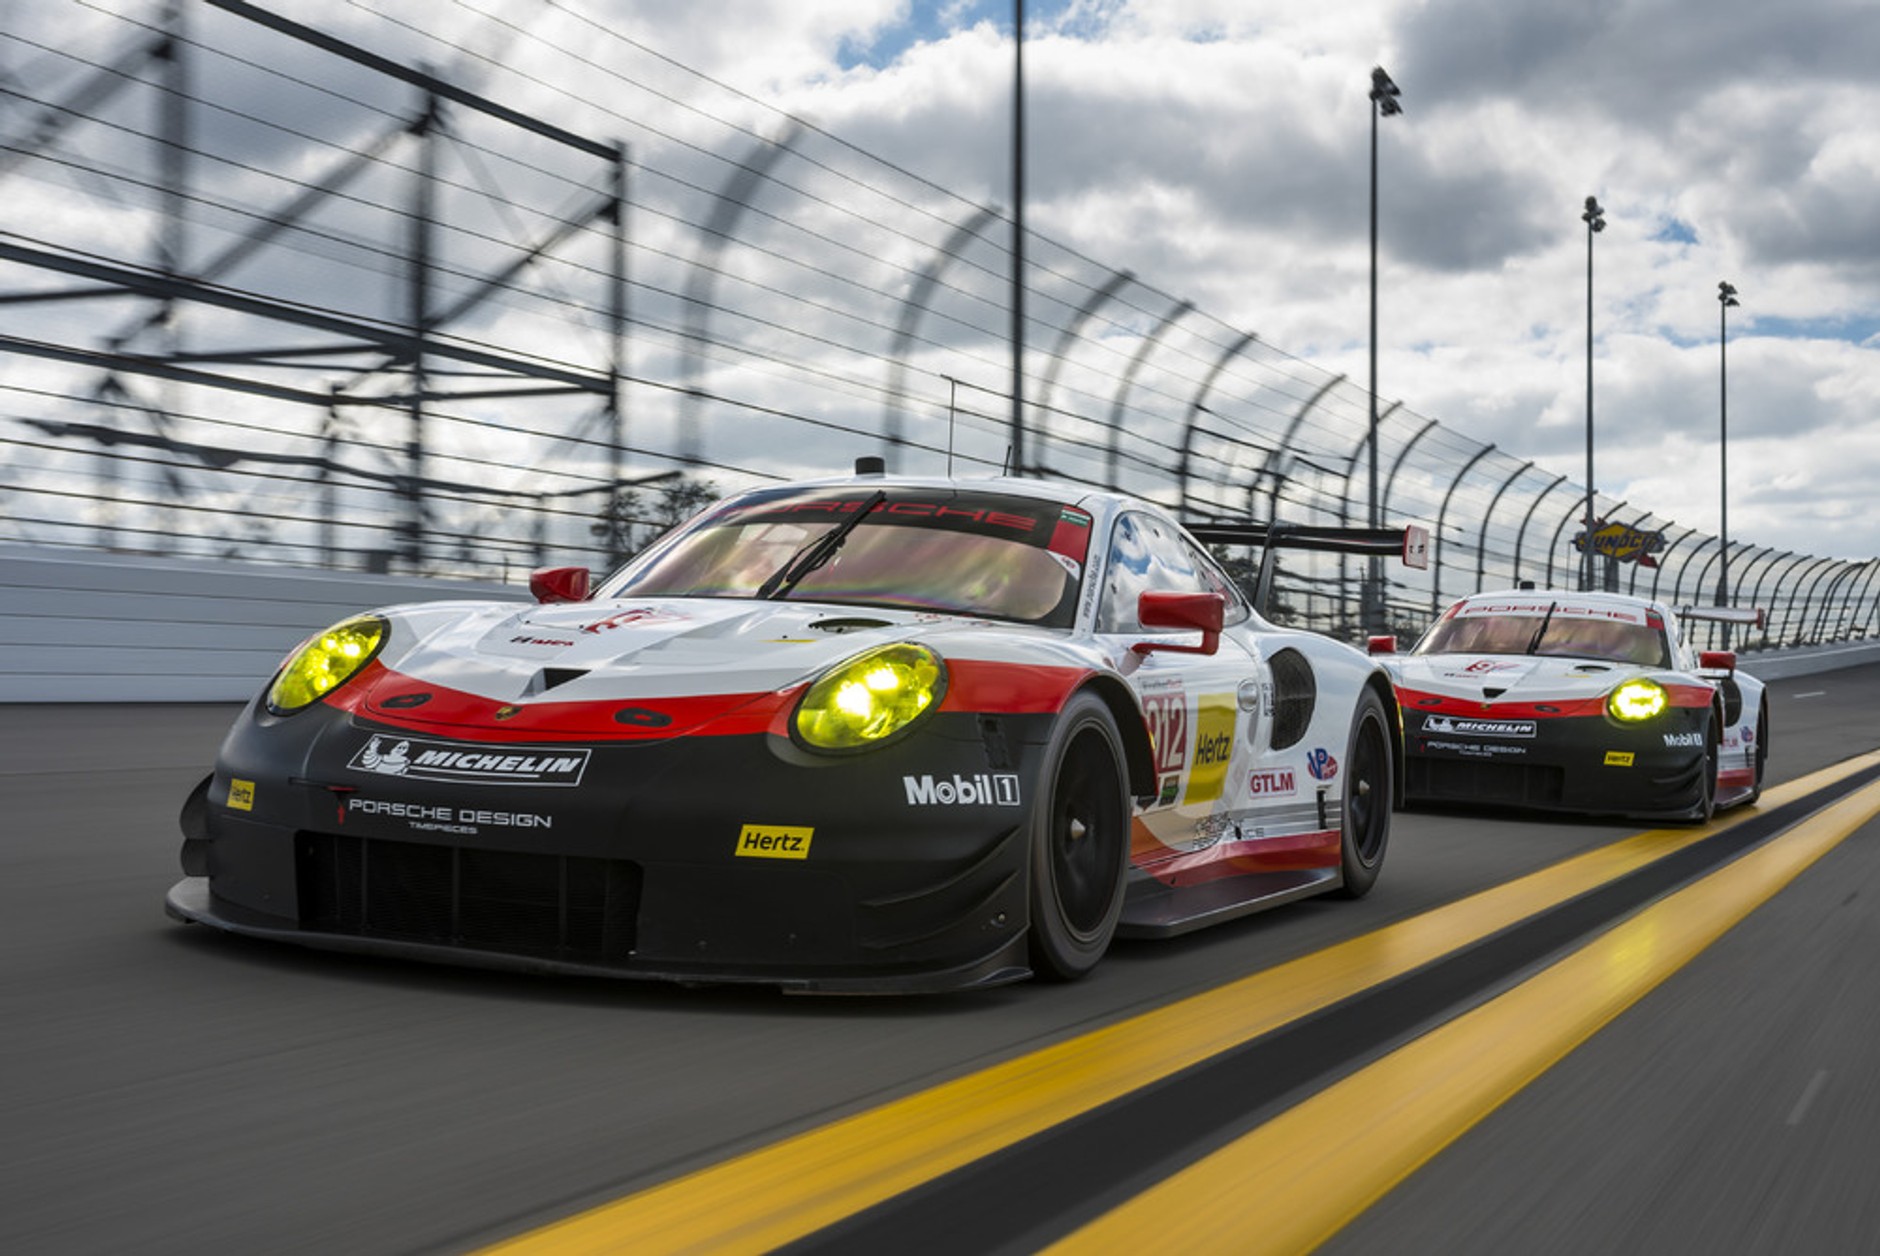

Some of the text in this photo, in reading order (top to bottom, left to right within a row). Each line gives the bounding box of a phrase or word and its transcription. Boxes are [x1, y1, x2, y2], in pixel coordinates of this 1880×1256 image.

[1457, 722, 1533, 733] MICHELIN
[1195, 731, 1230, 765] Hertz
[414, 750, 583, 773] MICHELIN
[903, 774, 993, 805] Mobil
[1251, 772, 1294, 794] GTLM
[349, 799, 552, 829] PORSCHE DESIGN
[409, 821, 478, 834] TIMEPIECES
